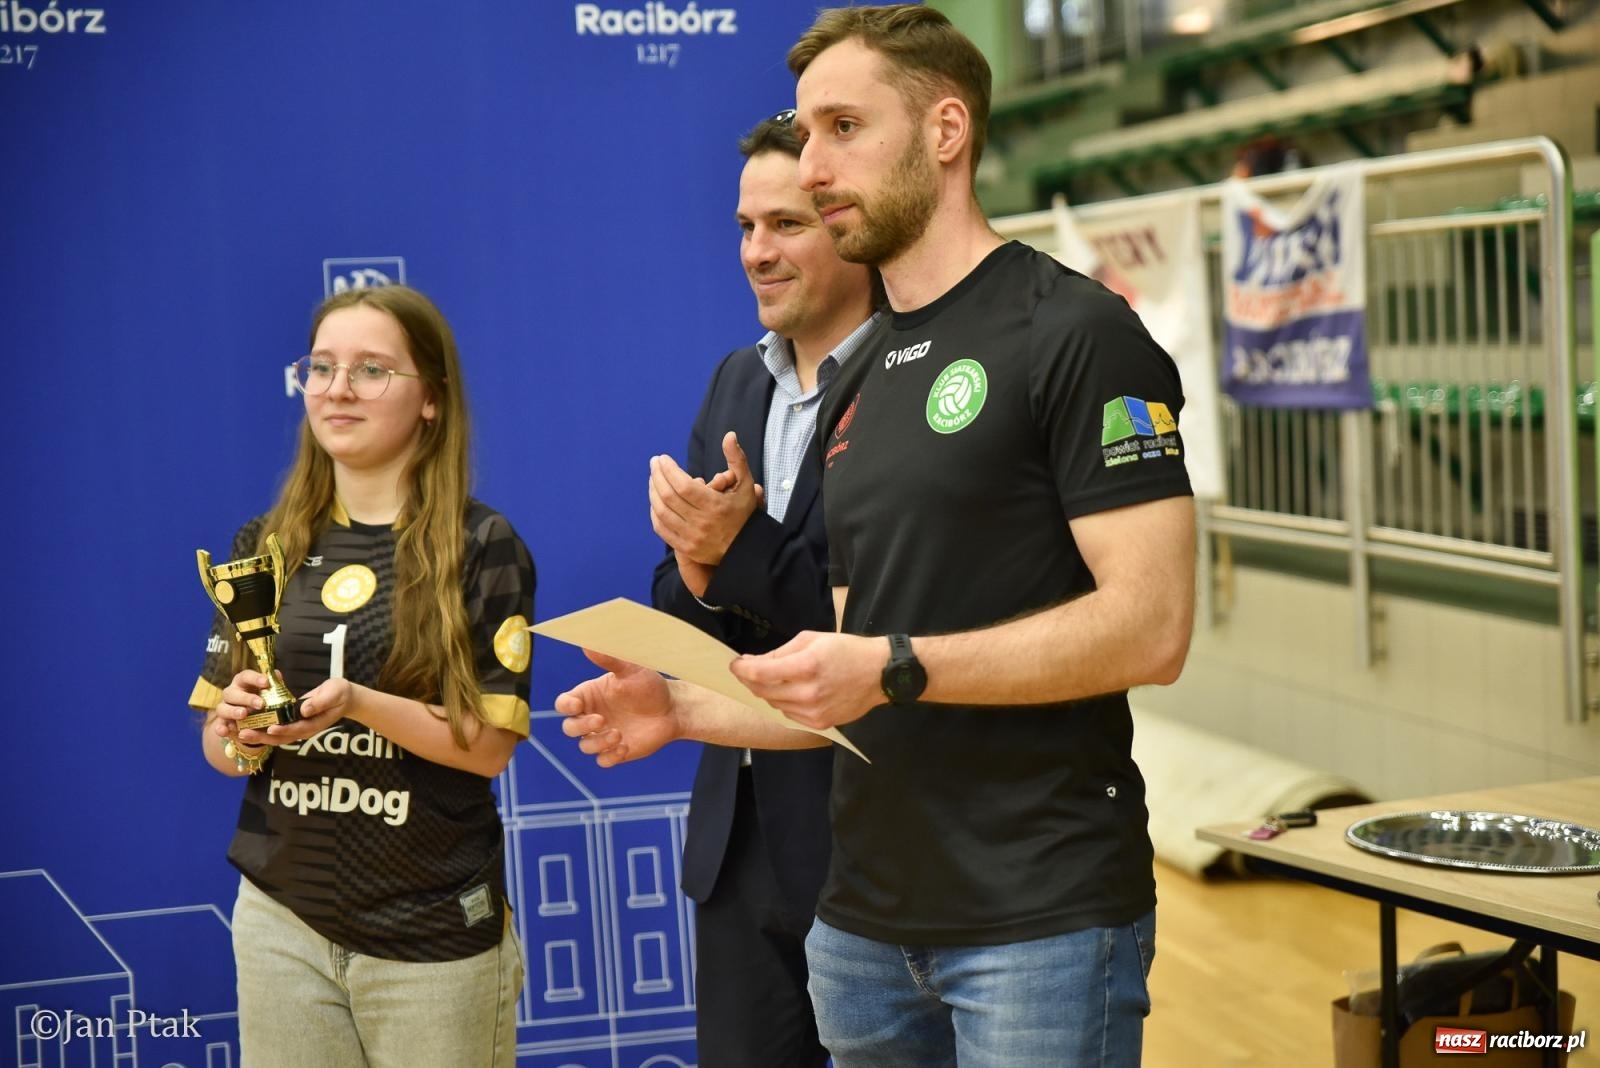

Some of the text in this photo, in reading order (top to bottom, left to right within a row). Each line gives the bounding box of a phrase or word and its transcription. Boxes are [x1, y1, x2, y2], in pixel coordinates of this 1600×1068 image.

[575, 1, 738, 36] Racibórz
[636, 43, 681, 68] 1217
[322, 624, 348, 679] 1
[268, 774, 410, 827] ropiDog
